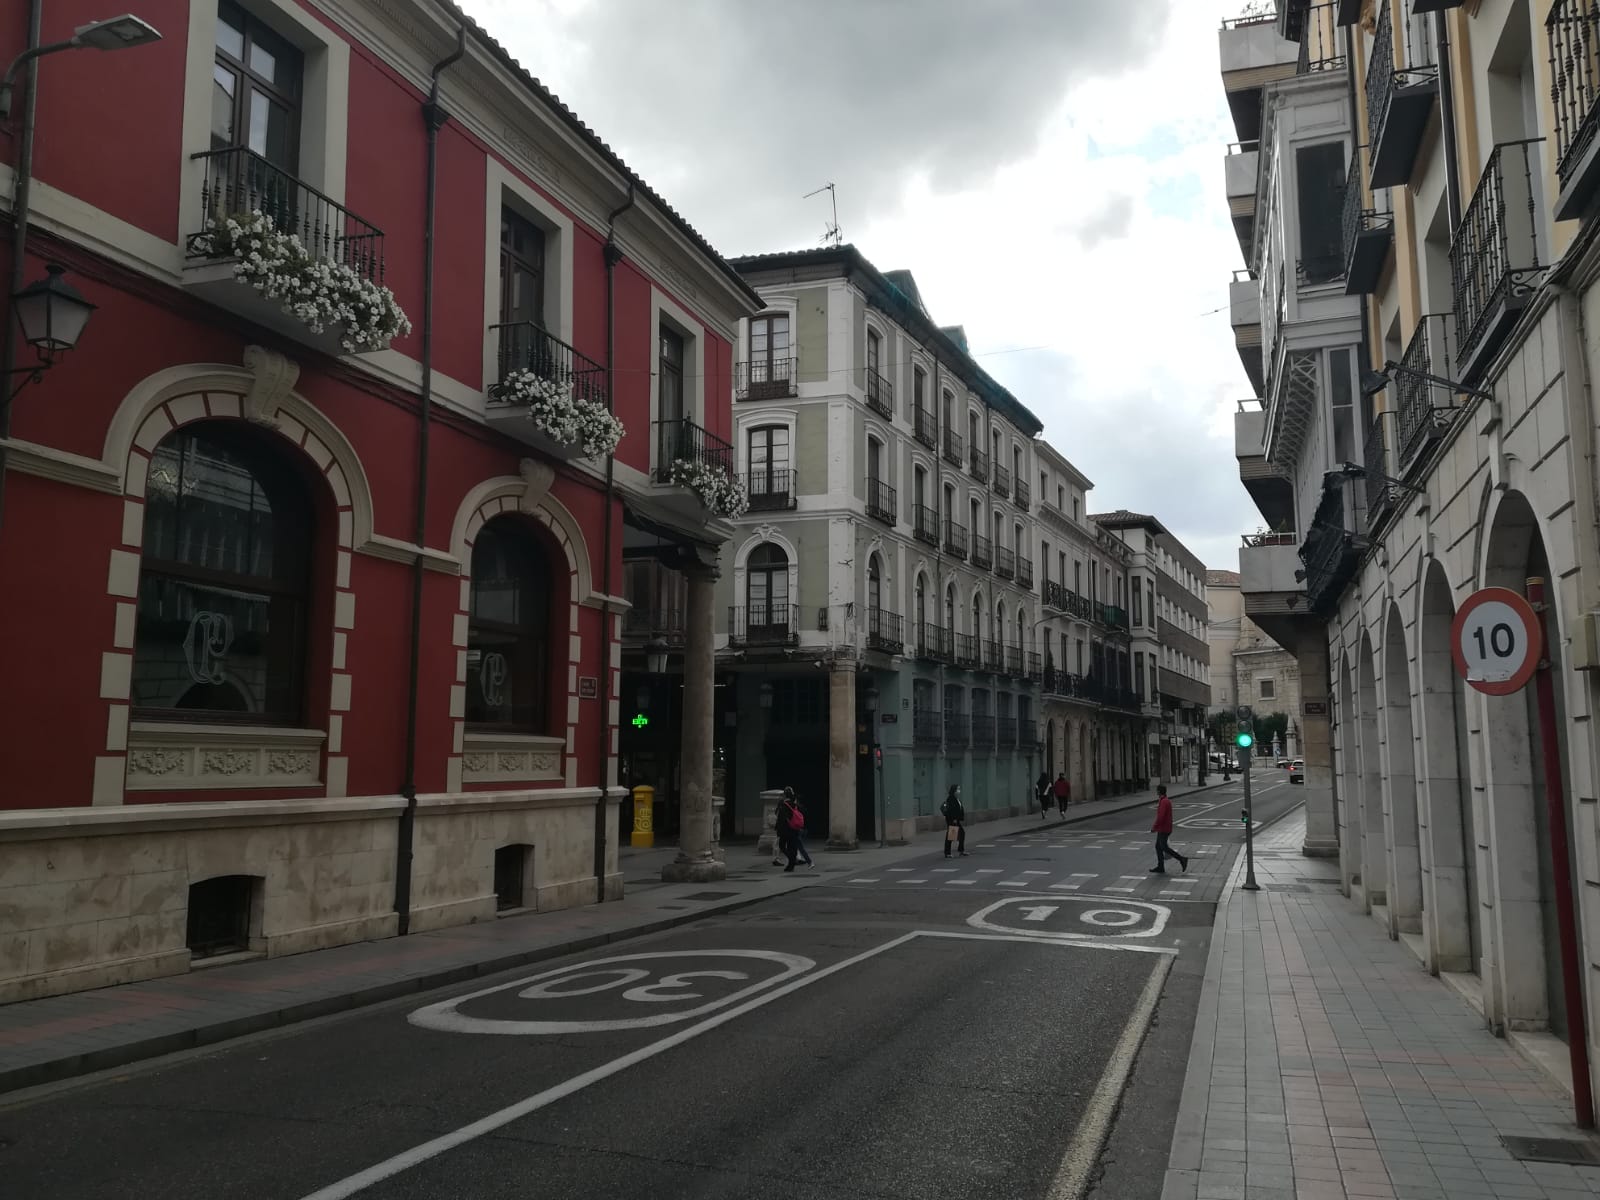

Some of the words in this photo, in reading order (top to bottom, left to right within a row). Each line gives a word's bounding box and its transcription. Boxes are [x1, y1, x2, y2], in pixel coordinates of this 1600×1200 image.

[1473, 623, 1515, 659] 10
[1018, 905, 1143, 927] 10
[518, 967, 748, 1002] 30
